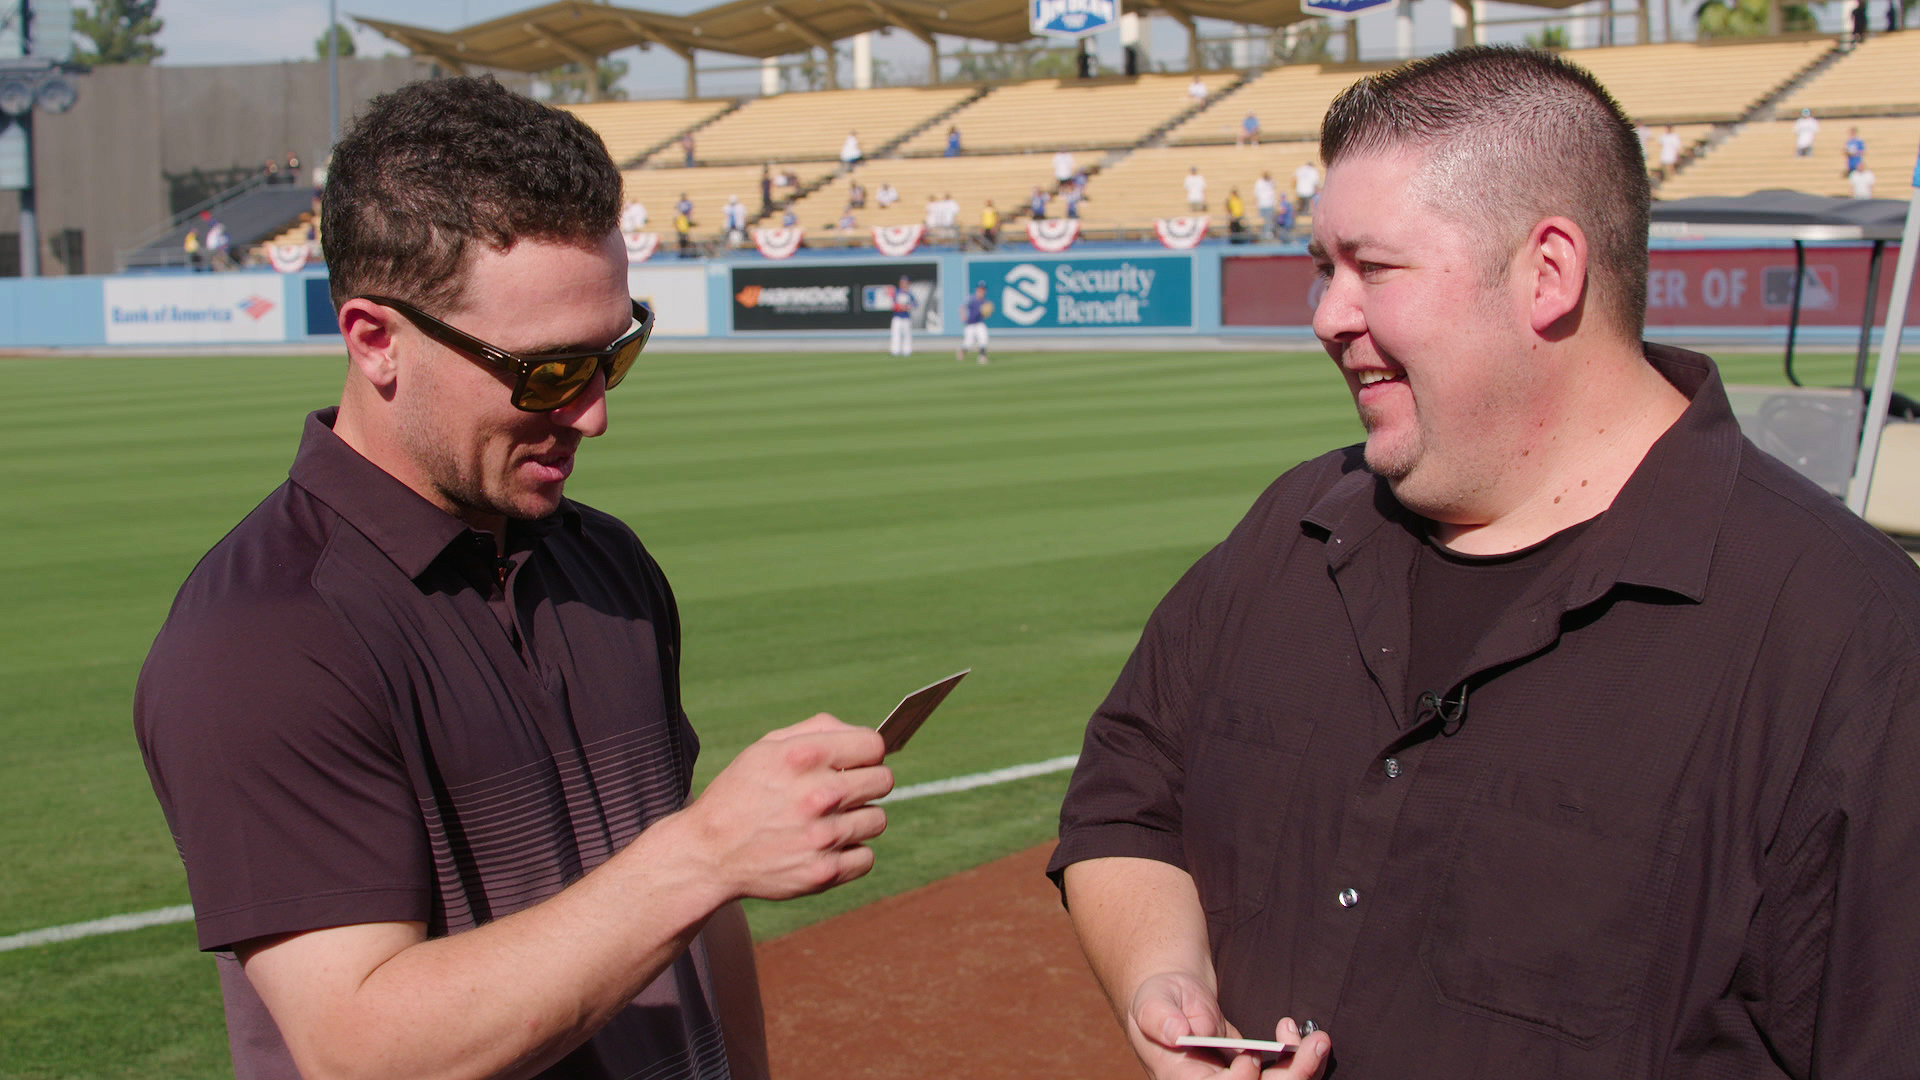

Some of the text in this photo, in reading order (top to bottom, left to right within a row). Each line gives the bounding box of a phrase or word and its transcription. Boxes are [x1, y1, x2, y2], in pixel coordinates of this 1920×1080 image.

[1055, 263, 1155, 298] Security
[1701, 268, 1747, 307] OF
[112, 305, 232, 323] Bank of America
[1057, 294, 1141, 323] Benefit
